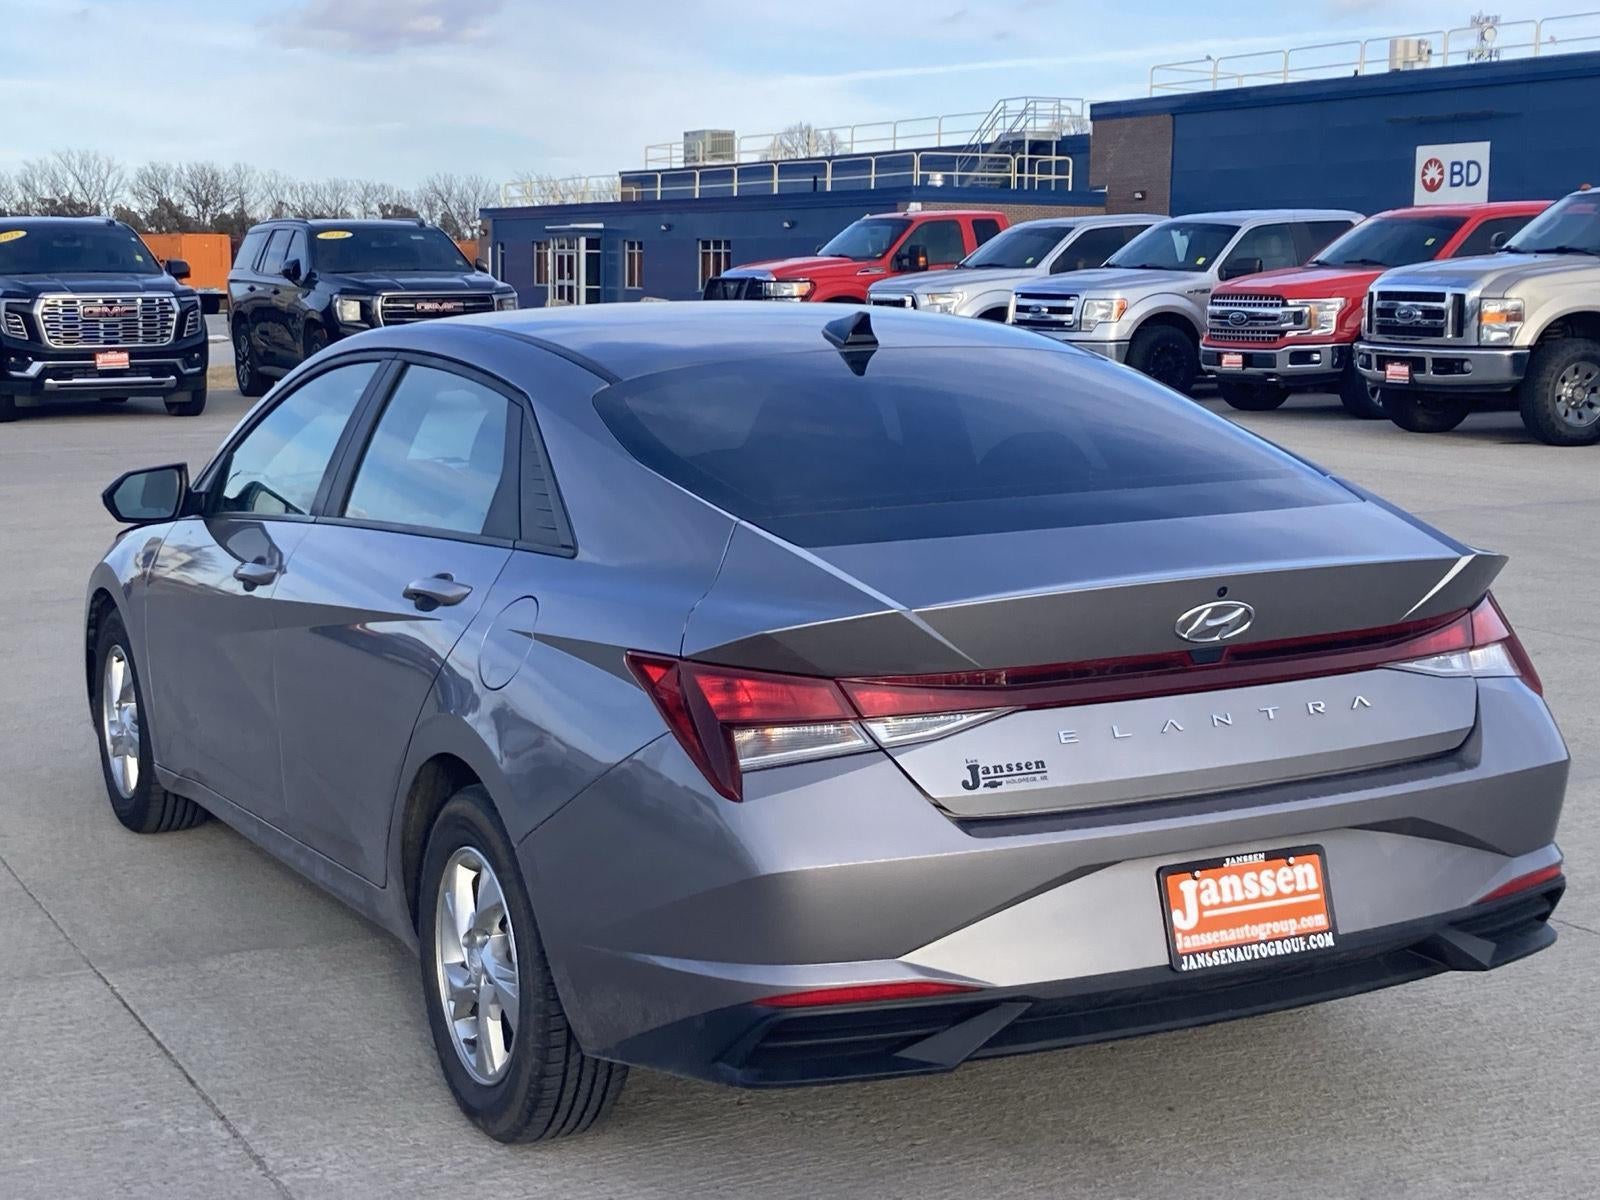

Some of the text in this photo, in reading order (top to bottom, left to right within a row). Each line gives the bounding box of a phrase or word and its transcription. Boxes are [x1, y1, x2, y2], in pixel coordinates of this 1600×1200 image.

[1450, 160, 1481, 187] BD
[1058, 695, 1371, 744] ELANTRA
[961, 760, 1046, 790] Janssen
[1223, 853, 1265, 867] JANSSEN
[1172, 862, 1319, 930] Janssen
[1176, 913, 1327, 950] Janssenautogroup.com
